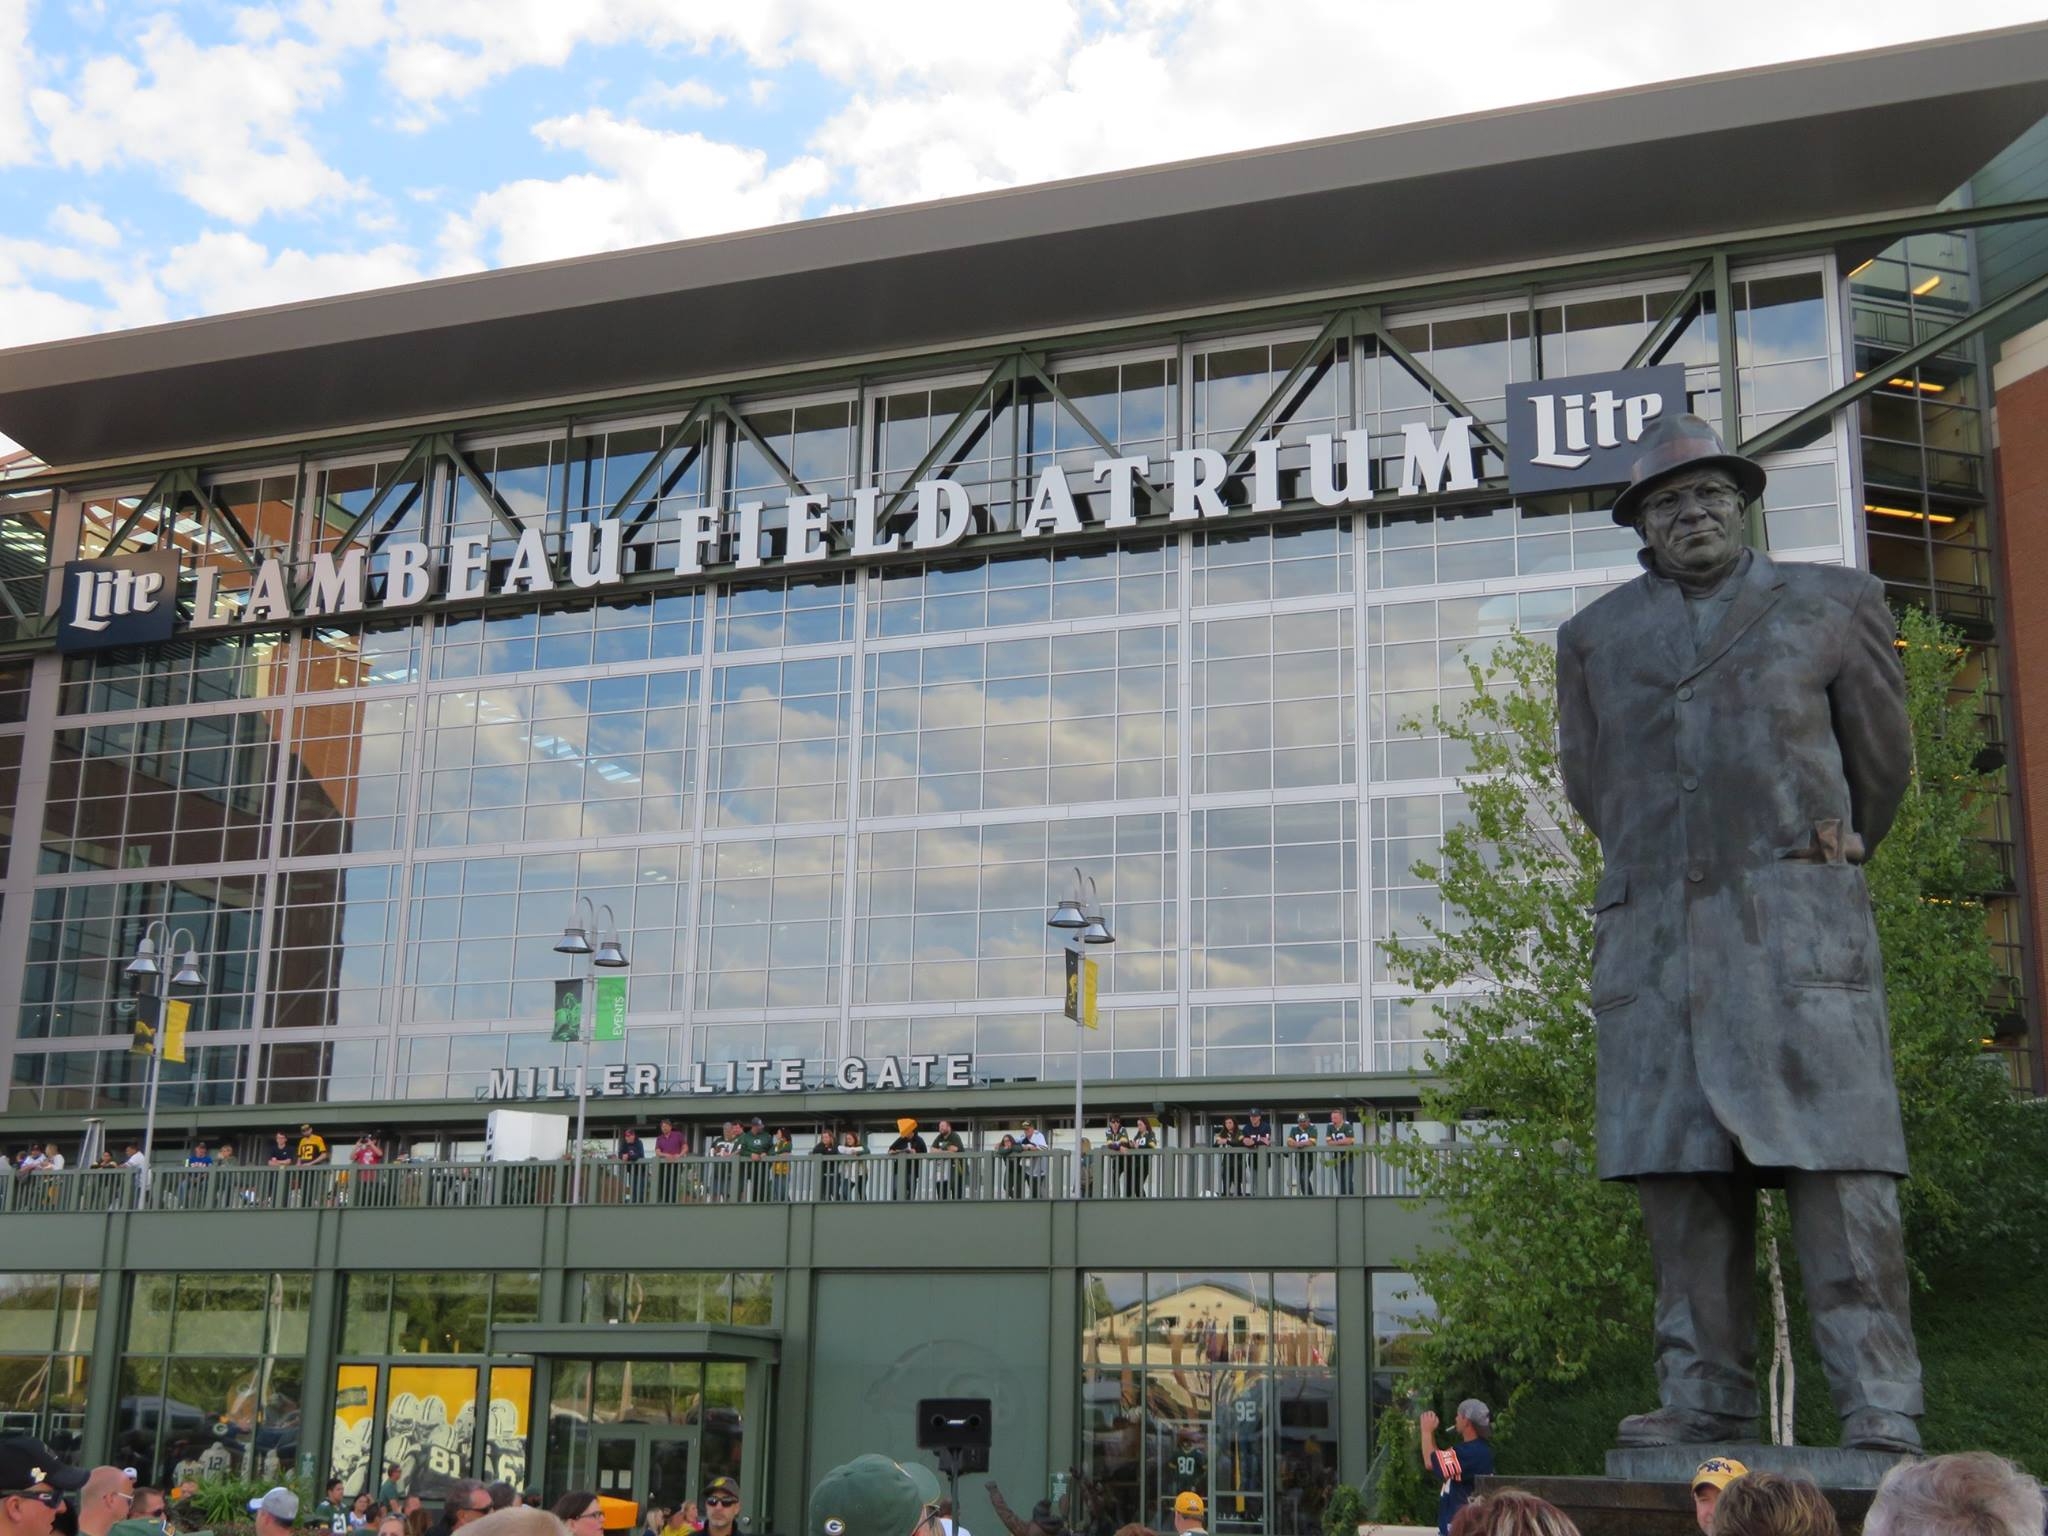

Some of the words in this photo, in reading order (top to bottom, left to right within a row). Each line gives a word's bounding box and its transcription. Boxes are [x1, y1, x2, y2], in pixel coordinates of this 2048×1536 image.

[1528, 390, 1663, 469] Lite
[190, 518, 623, 629] LAMBEAU
[674, 478, 971, 576] FIELD
[1021, 416, 1479, 538] ATRIUM
[69, 569, 163, 632] Lite
[612, 996, 625, 1036] EVENTS
[488, 1062, 661, 1100] MILLER
[693, 1057, 806, 1094] LITE
[837, 1052, 974, 1091] GATE
[301, 1145, 314, 1160] 12
[1235, 1401, 1257, 1422] 92
[208, 1456, 223, 1471] 12
[428, 1444, 461, 1479] 81
[1177, 1456, 1195, 1475] 80
[332, 1513, 347, 1534] 21
